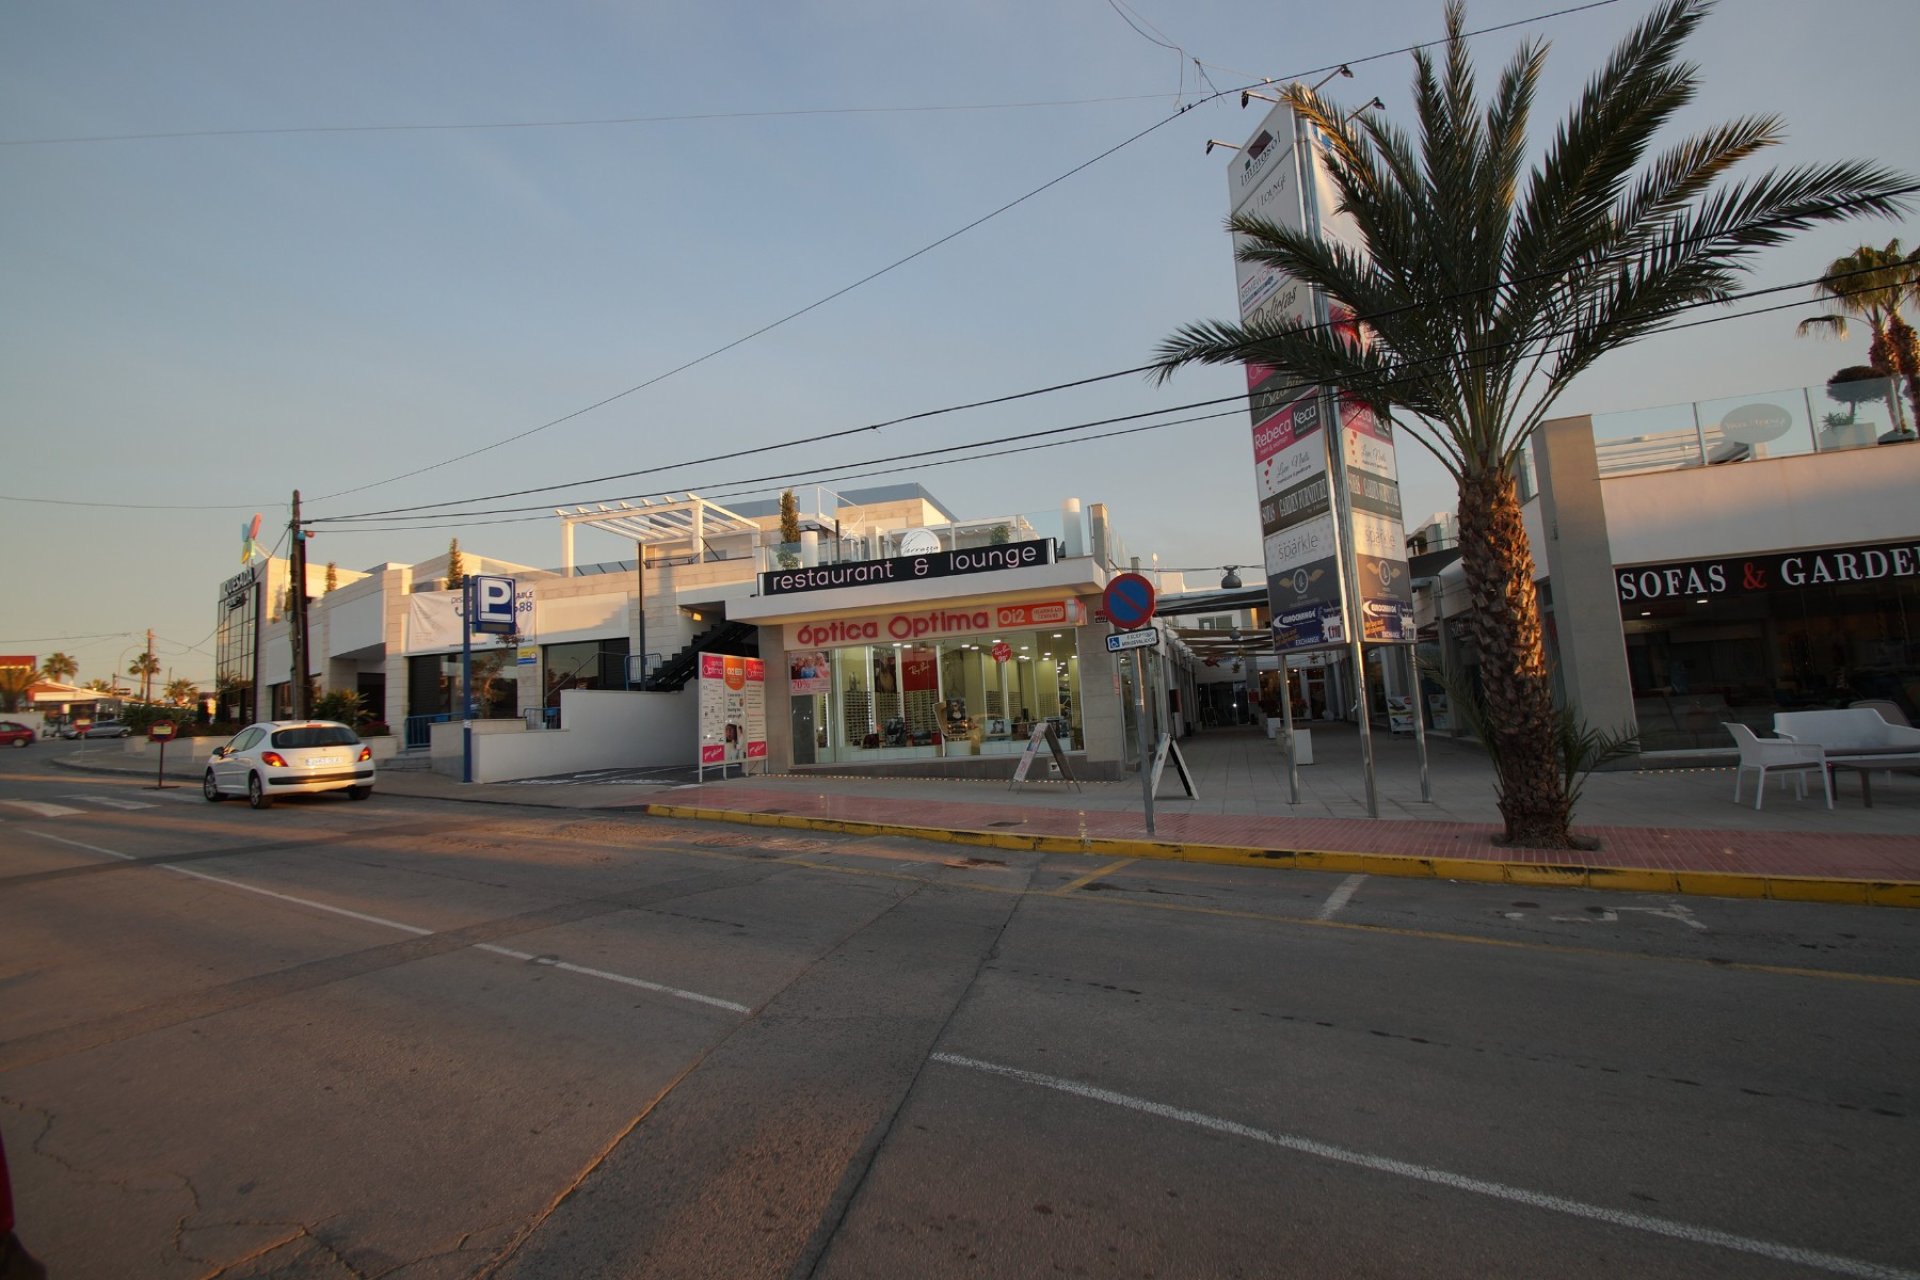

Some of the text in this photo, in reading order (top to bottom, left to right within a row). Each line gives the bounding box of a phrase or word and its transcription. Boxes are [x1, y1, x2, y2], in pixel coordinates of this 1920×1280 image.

[1255, 419, 1291, 450] Rebeca
[773, 546, 1037, 591] restaurant & lounge
[1619, 547, 1920, 601] SOFAS & GARDE
[481, 579, 511, 613] P
[797, 611, 989, 647] óptica Optima
